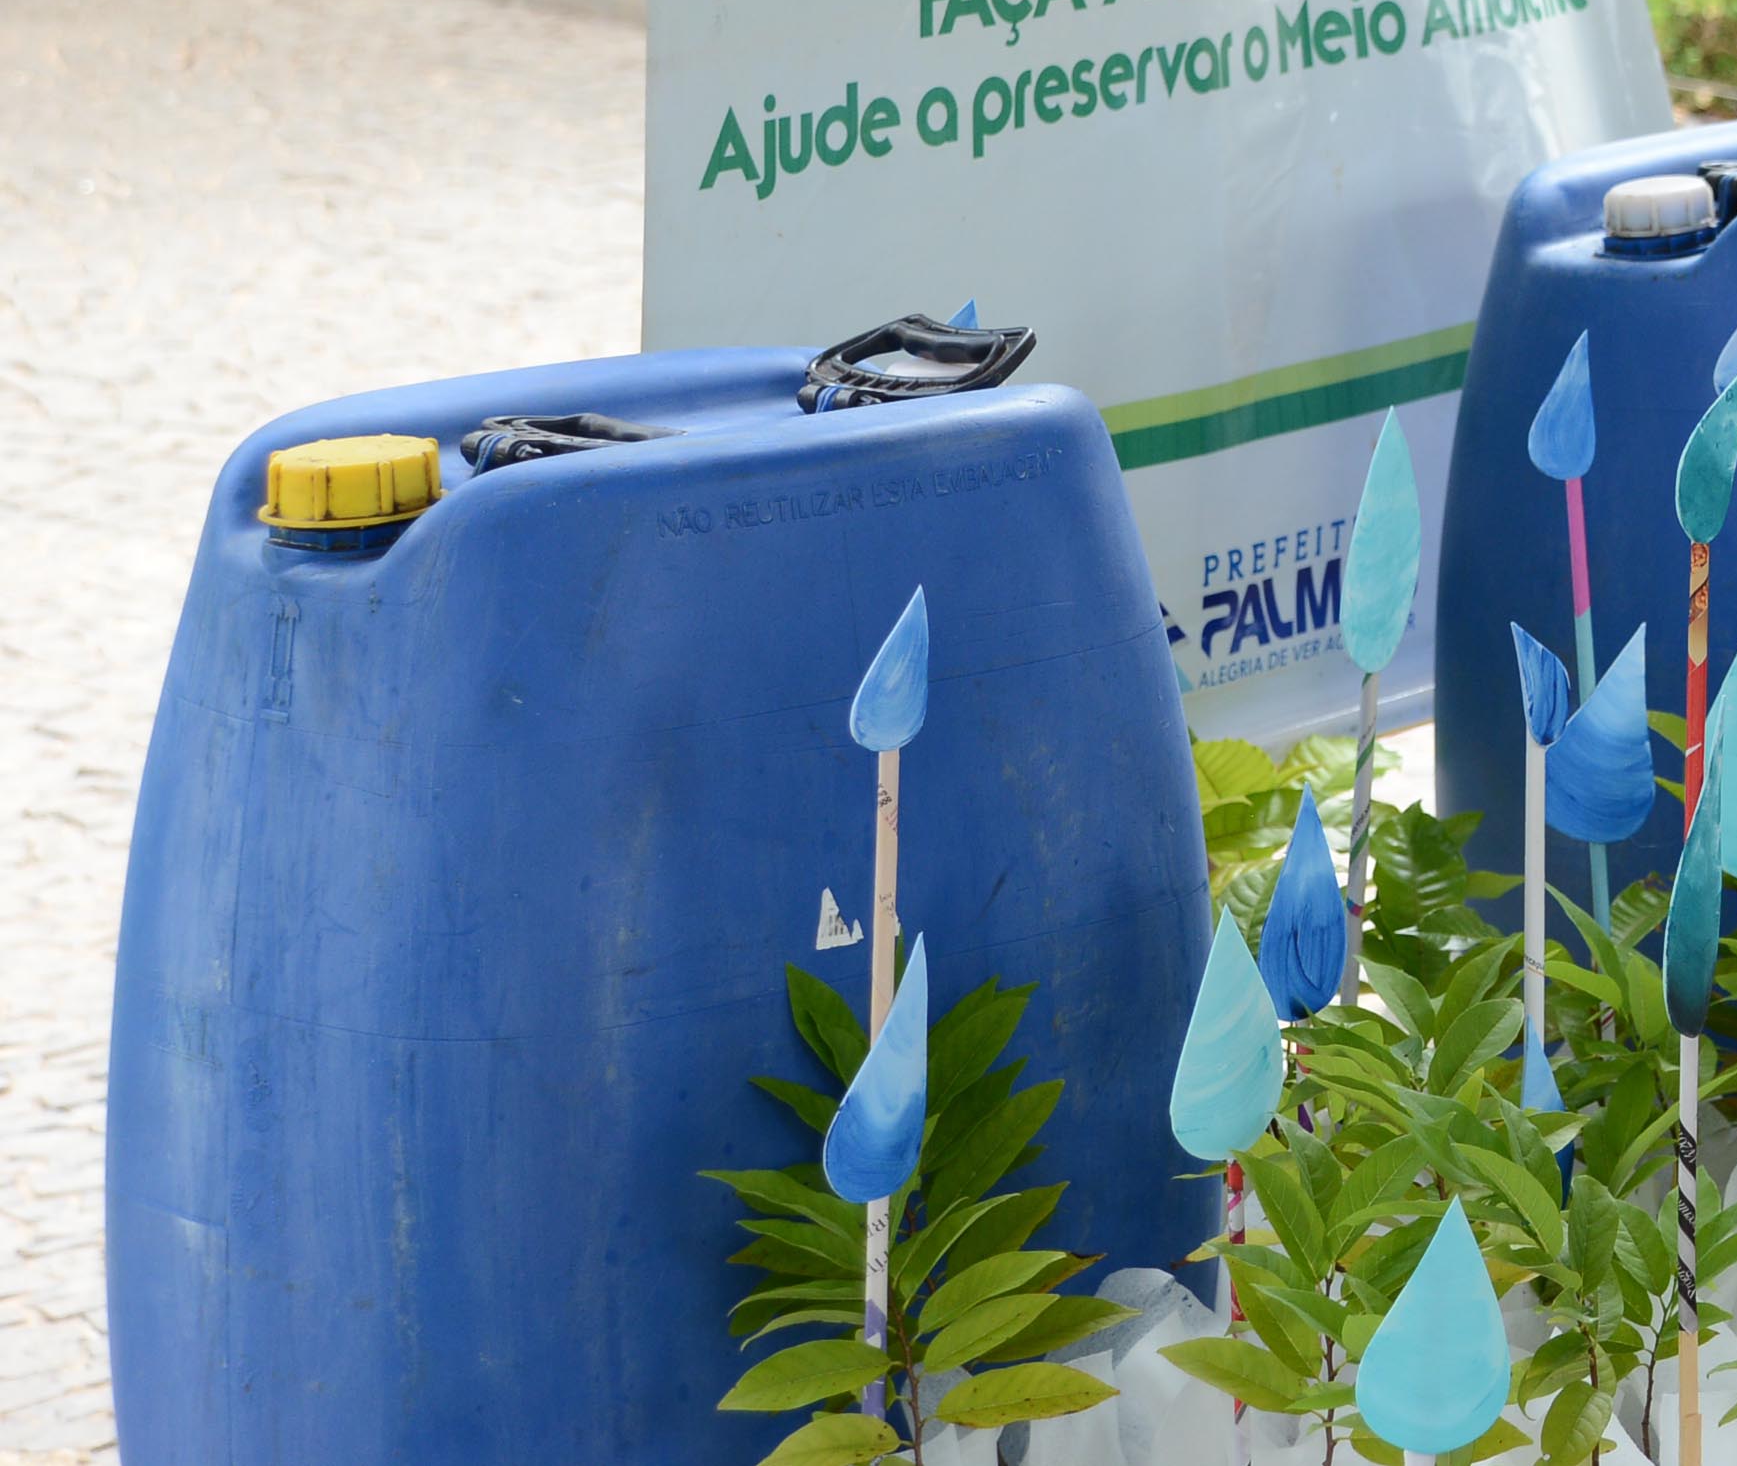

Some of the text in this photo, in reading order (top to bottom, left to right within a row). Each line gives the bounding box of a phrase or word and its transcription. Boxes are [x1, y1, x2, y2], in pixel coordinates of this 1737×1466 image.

[698, 80, 902, 201] Ajude
[915, 86, 959, 147] a
[972, 29, 1233, 159] preservar
[1243, 25, 1270, 81] o
[656, 505, 713, 538] NÃO
[724, 485, 865, 530] REUTILIZAR
[871, 476, 926, 508] ESTA
[1203, 514, 1358, 588] PREFEIT
[1200, 556, 1344, 660] PALM
[1199, 638, 1320, 689] ALEGRIA DE VER
